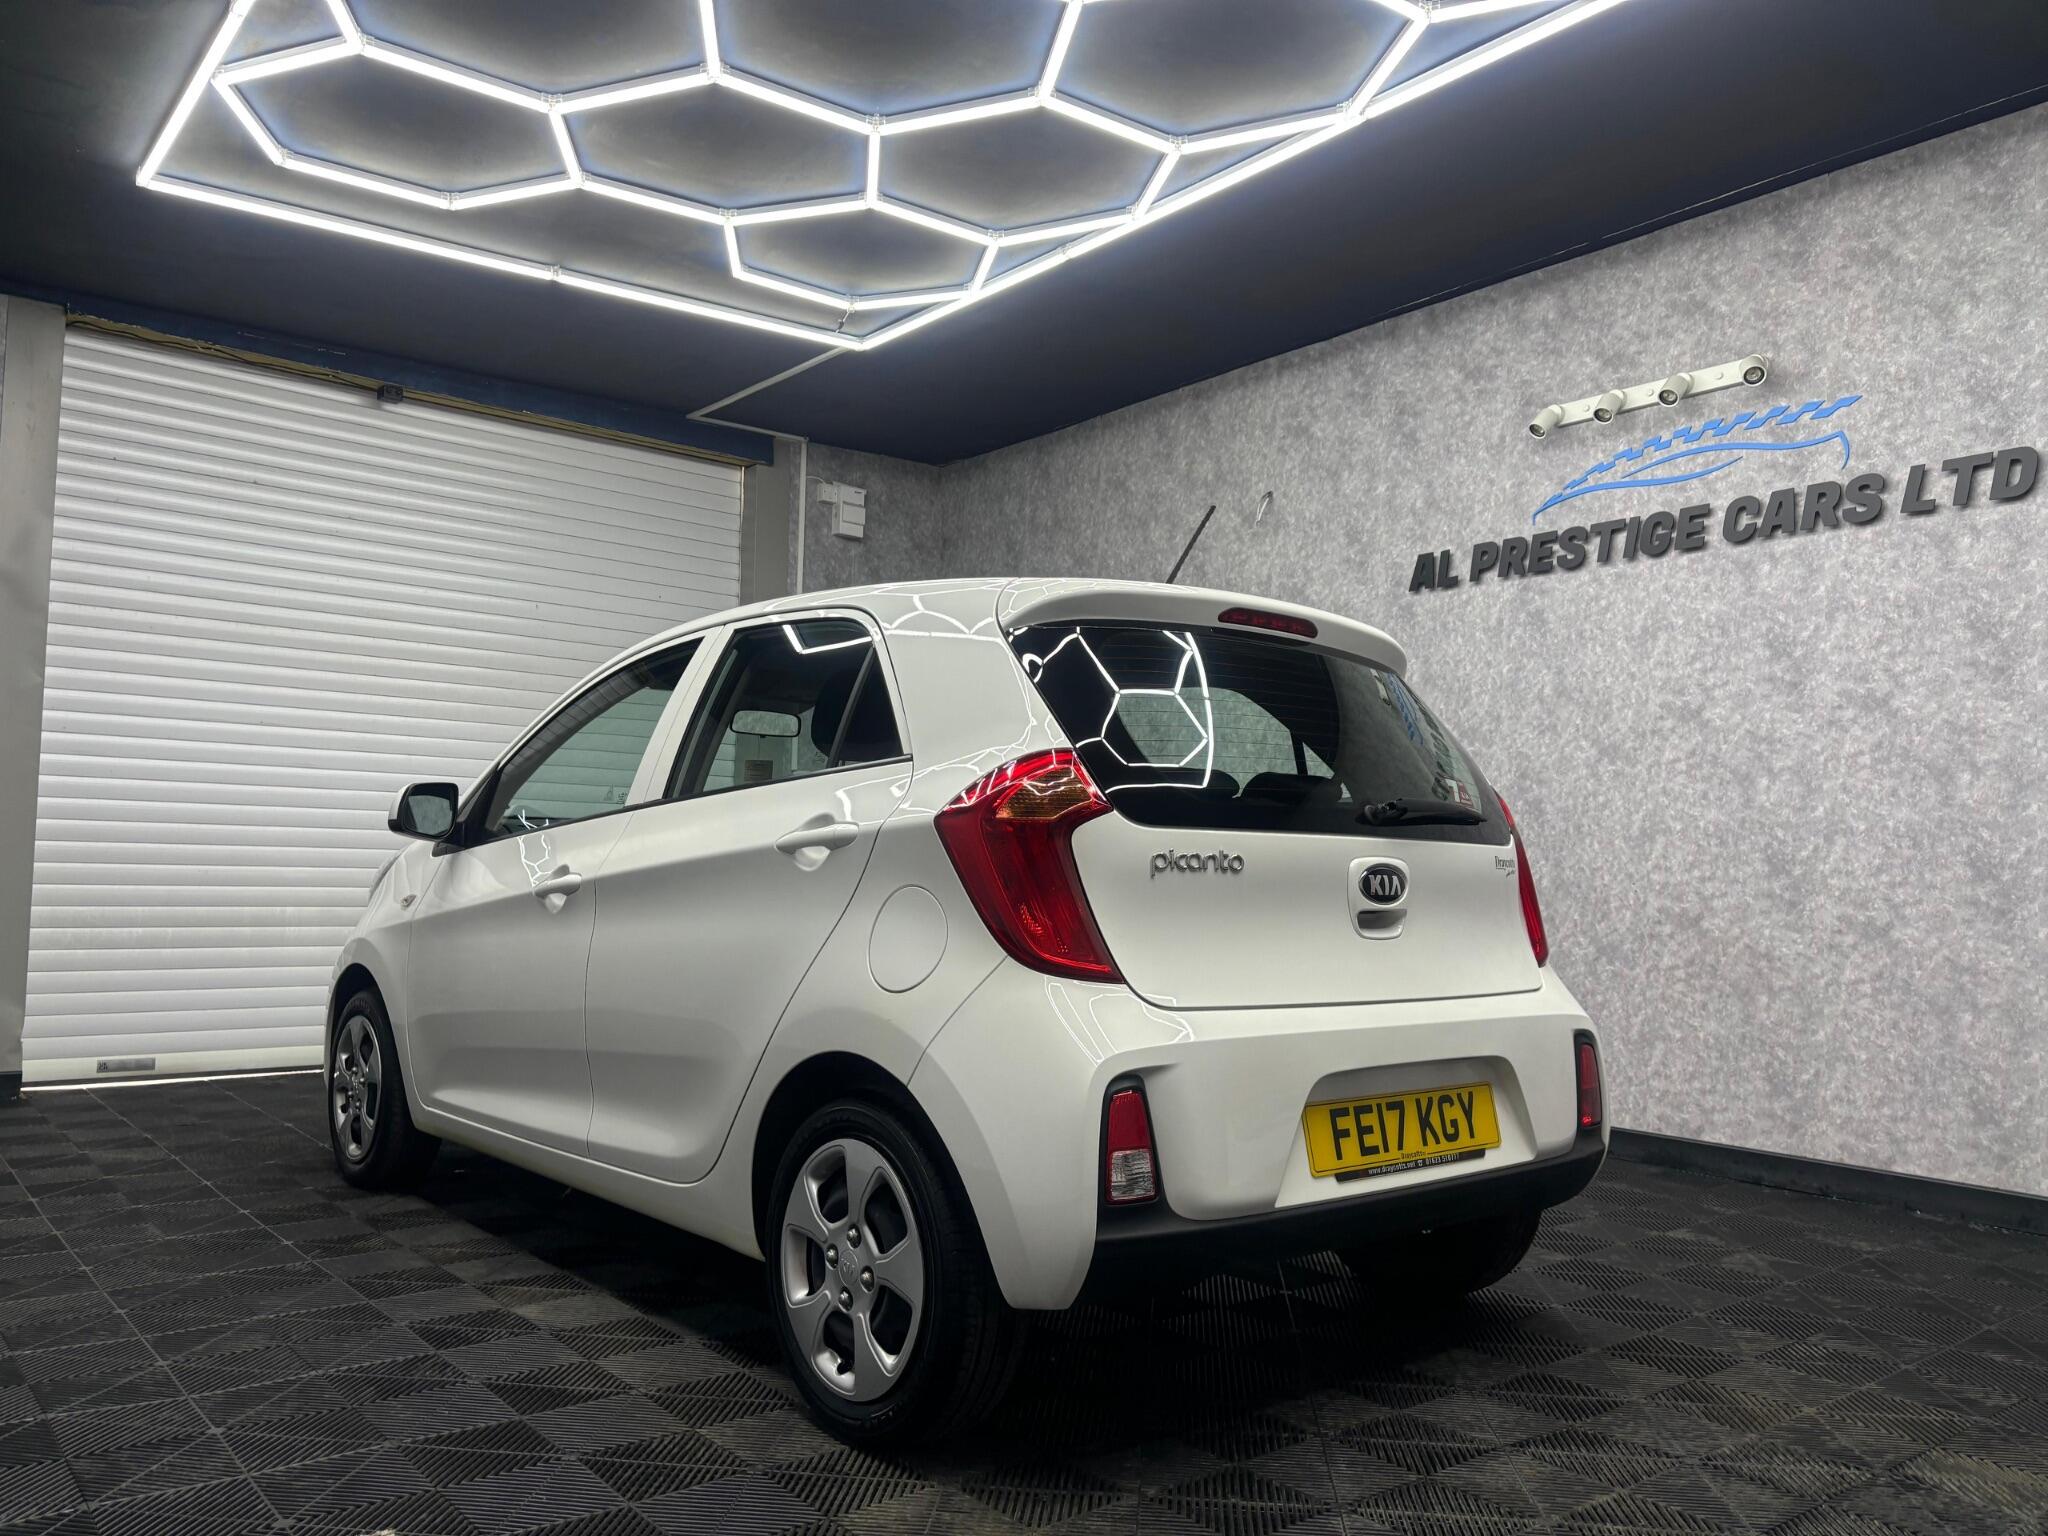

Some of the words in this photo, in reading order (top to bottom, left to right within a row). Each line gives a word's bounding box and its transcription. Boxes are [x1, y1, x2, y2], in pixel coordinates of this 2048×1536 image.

[1409, 548, 1459, 592] AL
[1470, 503, 1712, 582] PRESTIGE
[1722, 473, 1885, 545] CARS
[1900, 446, 2040, 514] LTD
[1150, 848, 1245, 880] picanto
[1368, 874, 1402, 896] KIA
[1329, 1100, 1405, 1160] FE17
[1415, 1091, 1475, 1147] KGY
